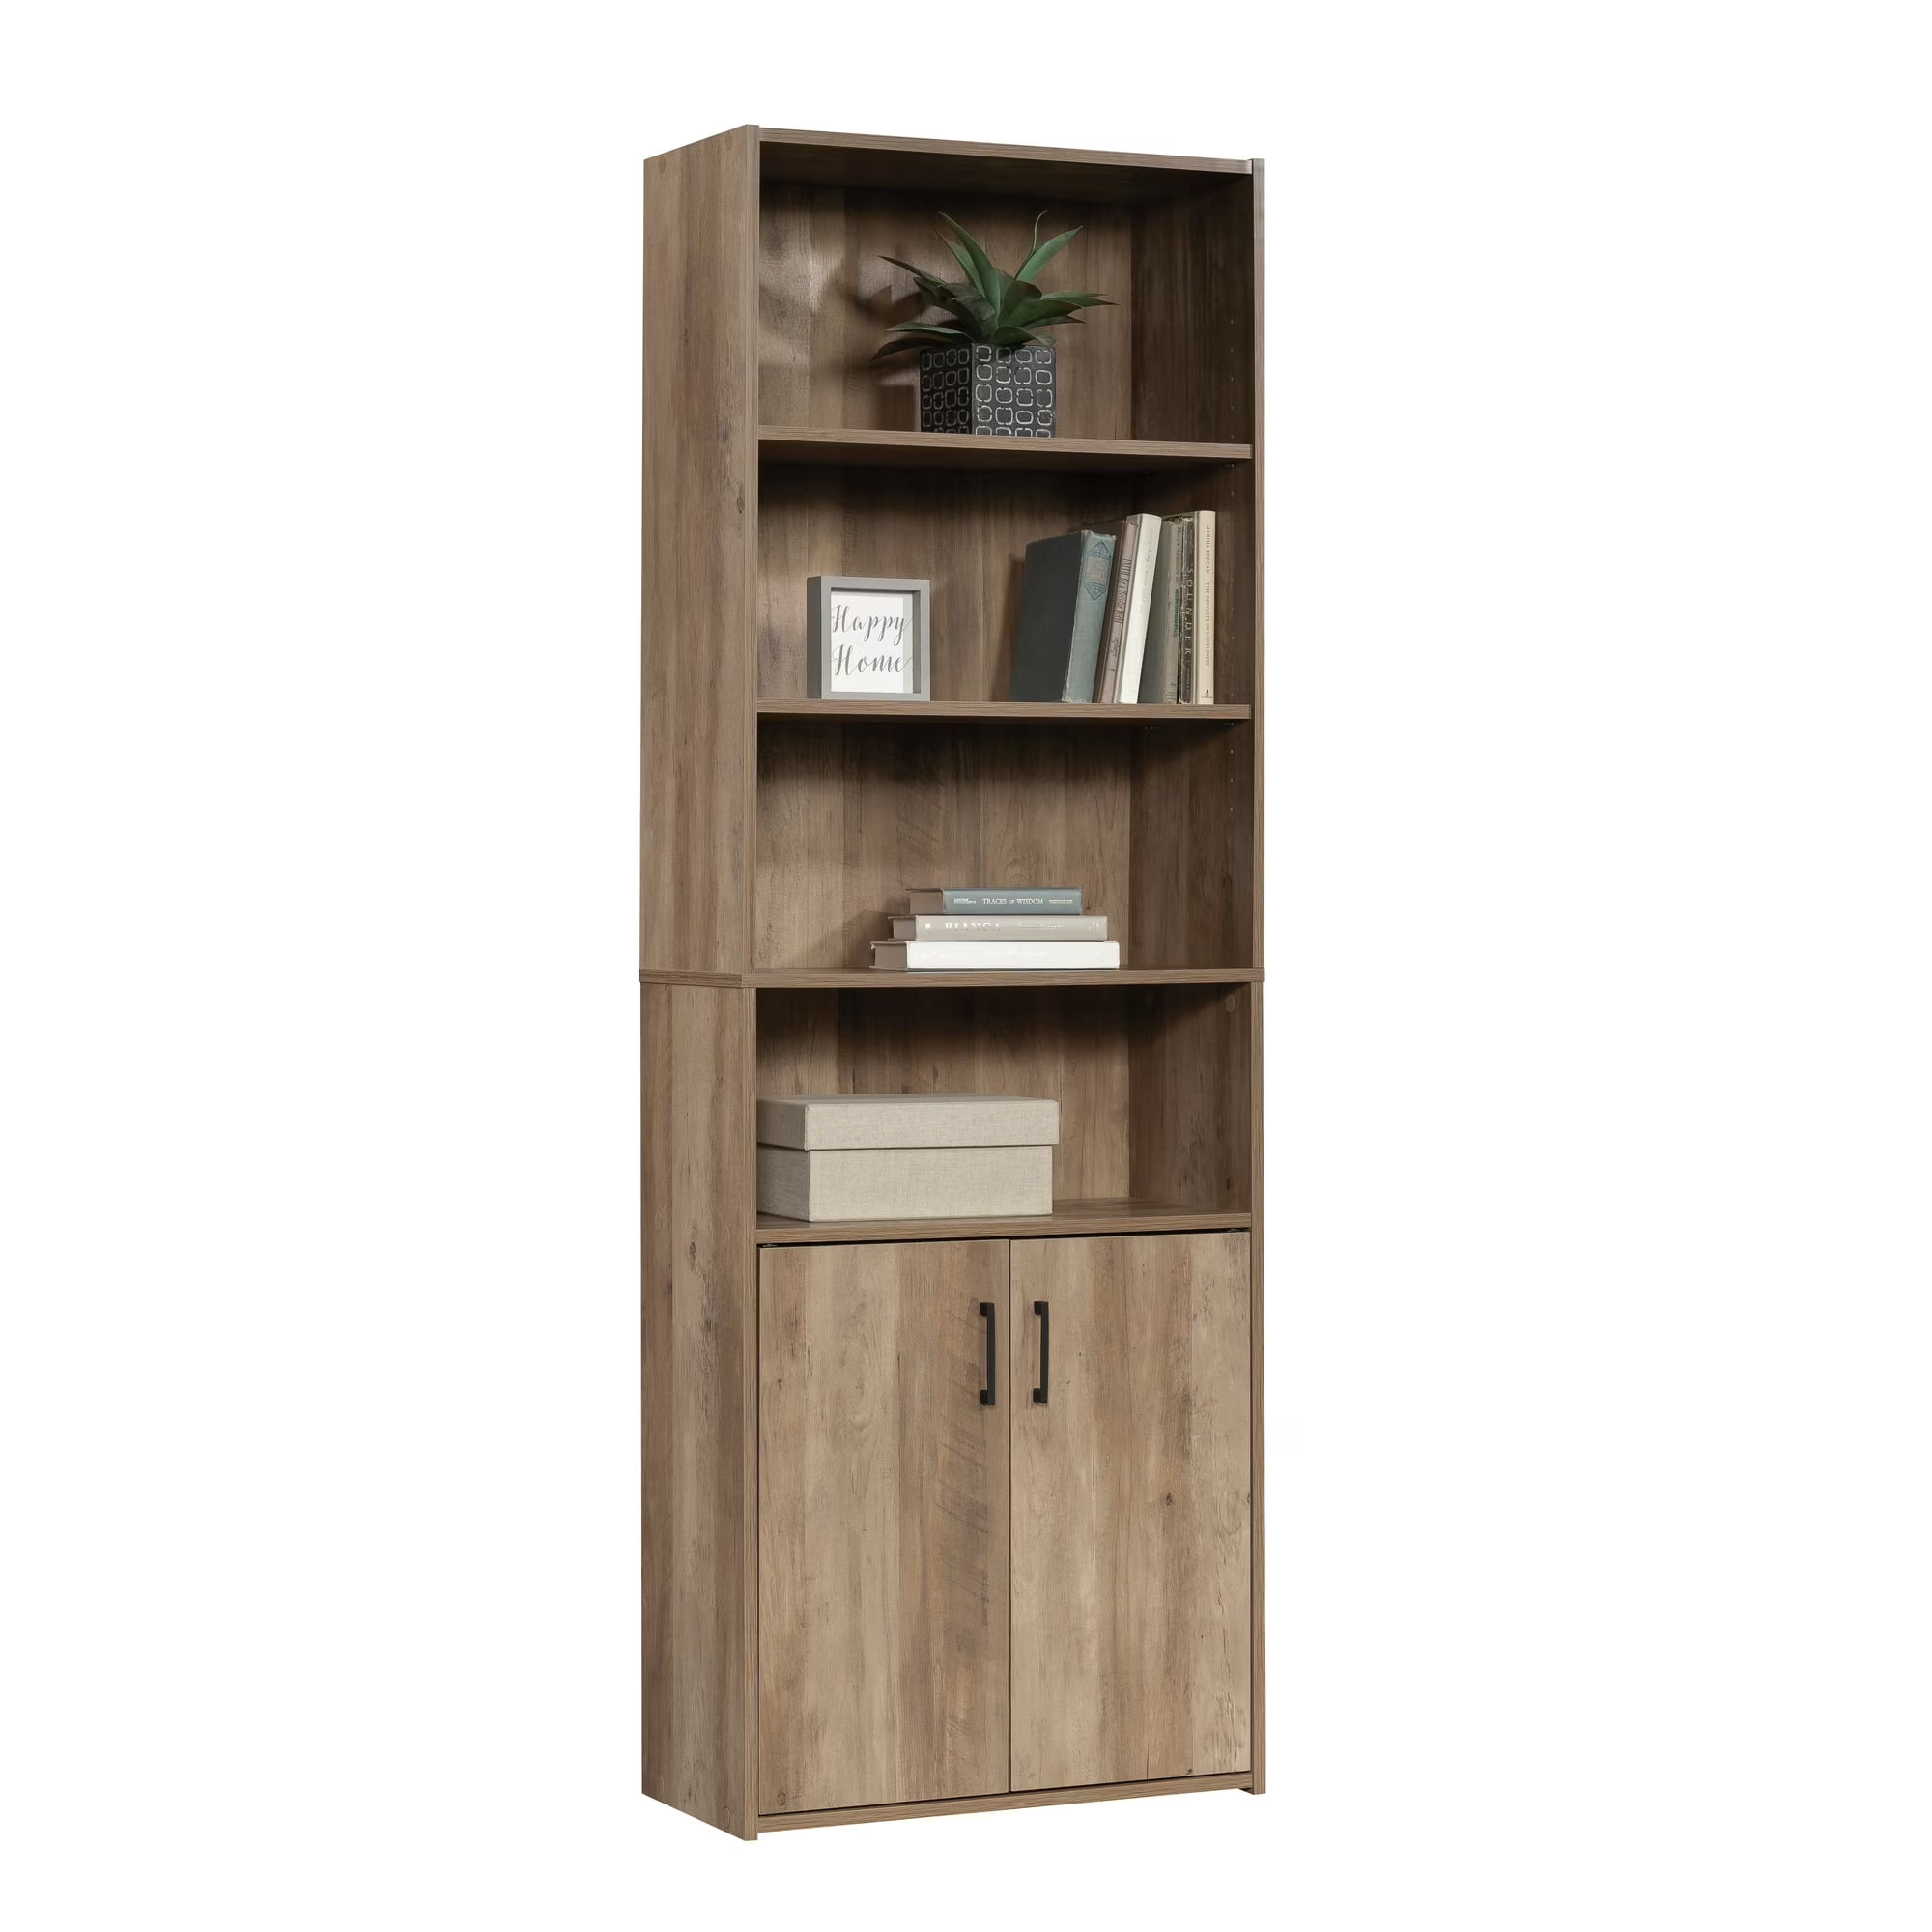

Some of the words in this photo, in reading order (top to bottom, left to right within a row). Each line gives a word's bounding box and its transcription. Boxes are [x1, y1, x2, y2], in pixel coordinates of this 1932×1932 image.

[831, 604, 912, 646] Happy
[1184, 568, 1194, 655] SOUNDER
[831, 644, 913, 676] Home
